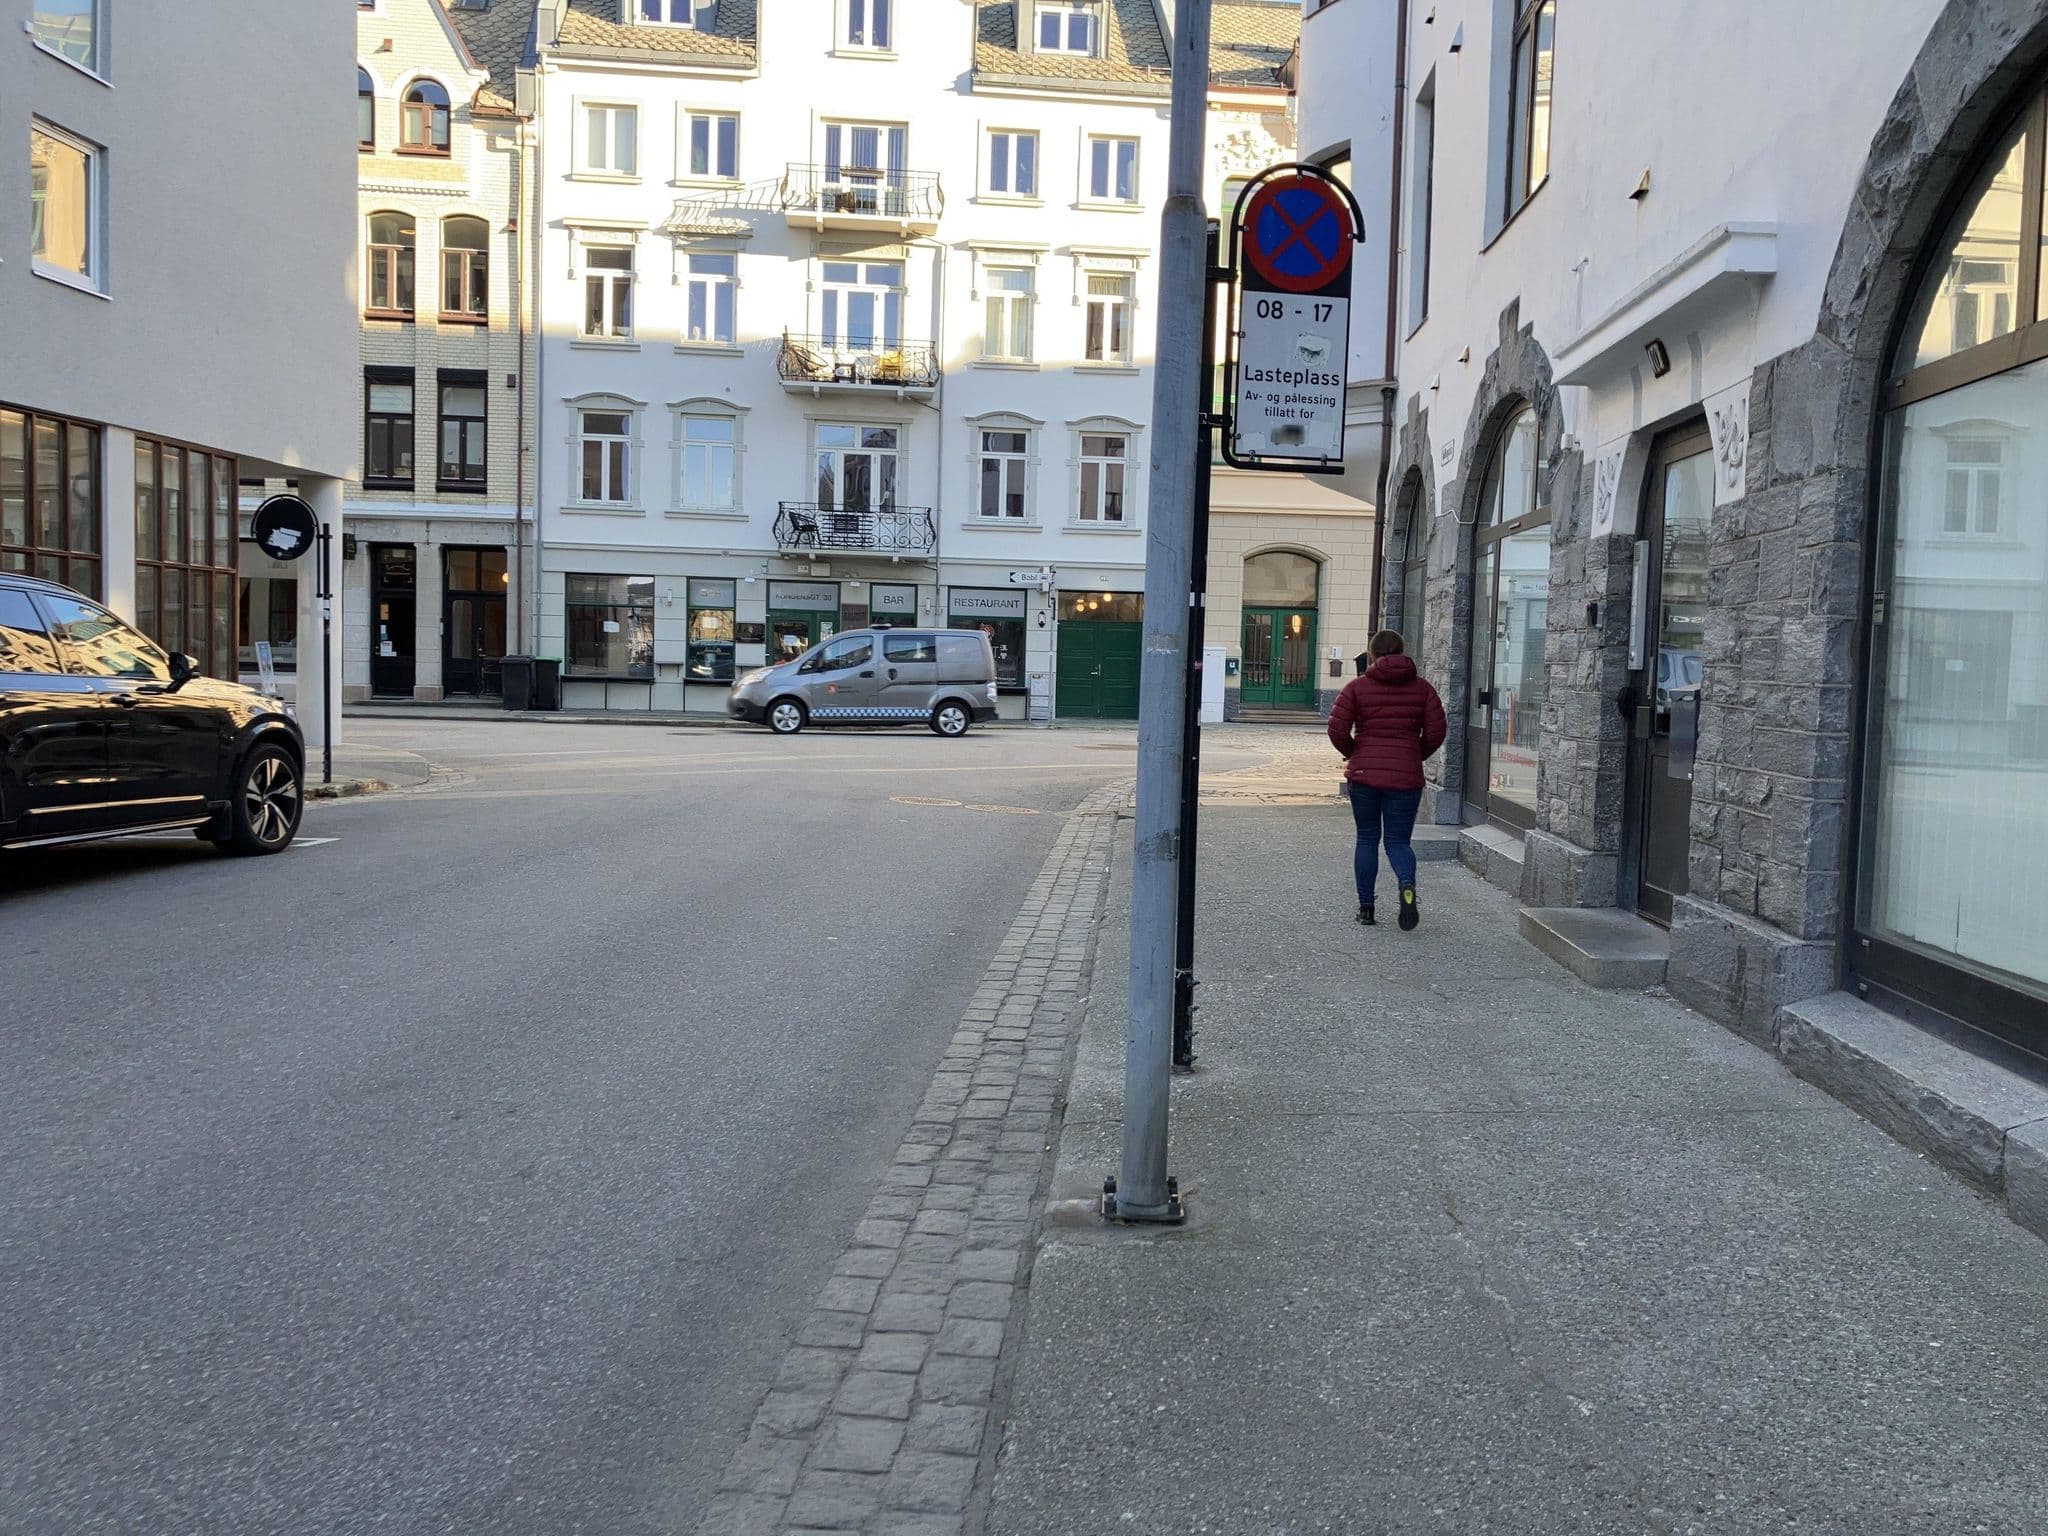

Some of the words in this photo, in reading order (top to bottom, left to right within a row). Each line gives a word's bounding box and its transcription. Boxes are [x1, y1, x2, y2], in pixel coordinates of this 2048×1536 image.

[1257, 299, 1283, 319] 08
[1314, 304, 1333, 322] 17
[1245, 365, 1339, 387] Lasteplass
[1245, 390, 1263, 401] Av-
[1266, 393, 1280, 404] og
[1284, 392, 1336, 407] pålessing
[1265, 406, 1295, 418] tillatt
[1300, 408, 1315, 419] for
[1021, 573, 1038, 581] Bobil
[883, 595, 904, 605] BAR
[954, 597, 1021, 609] RESTAURANT
